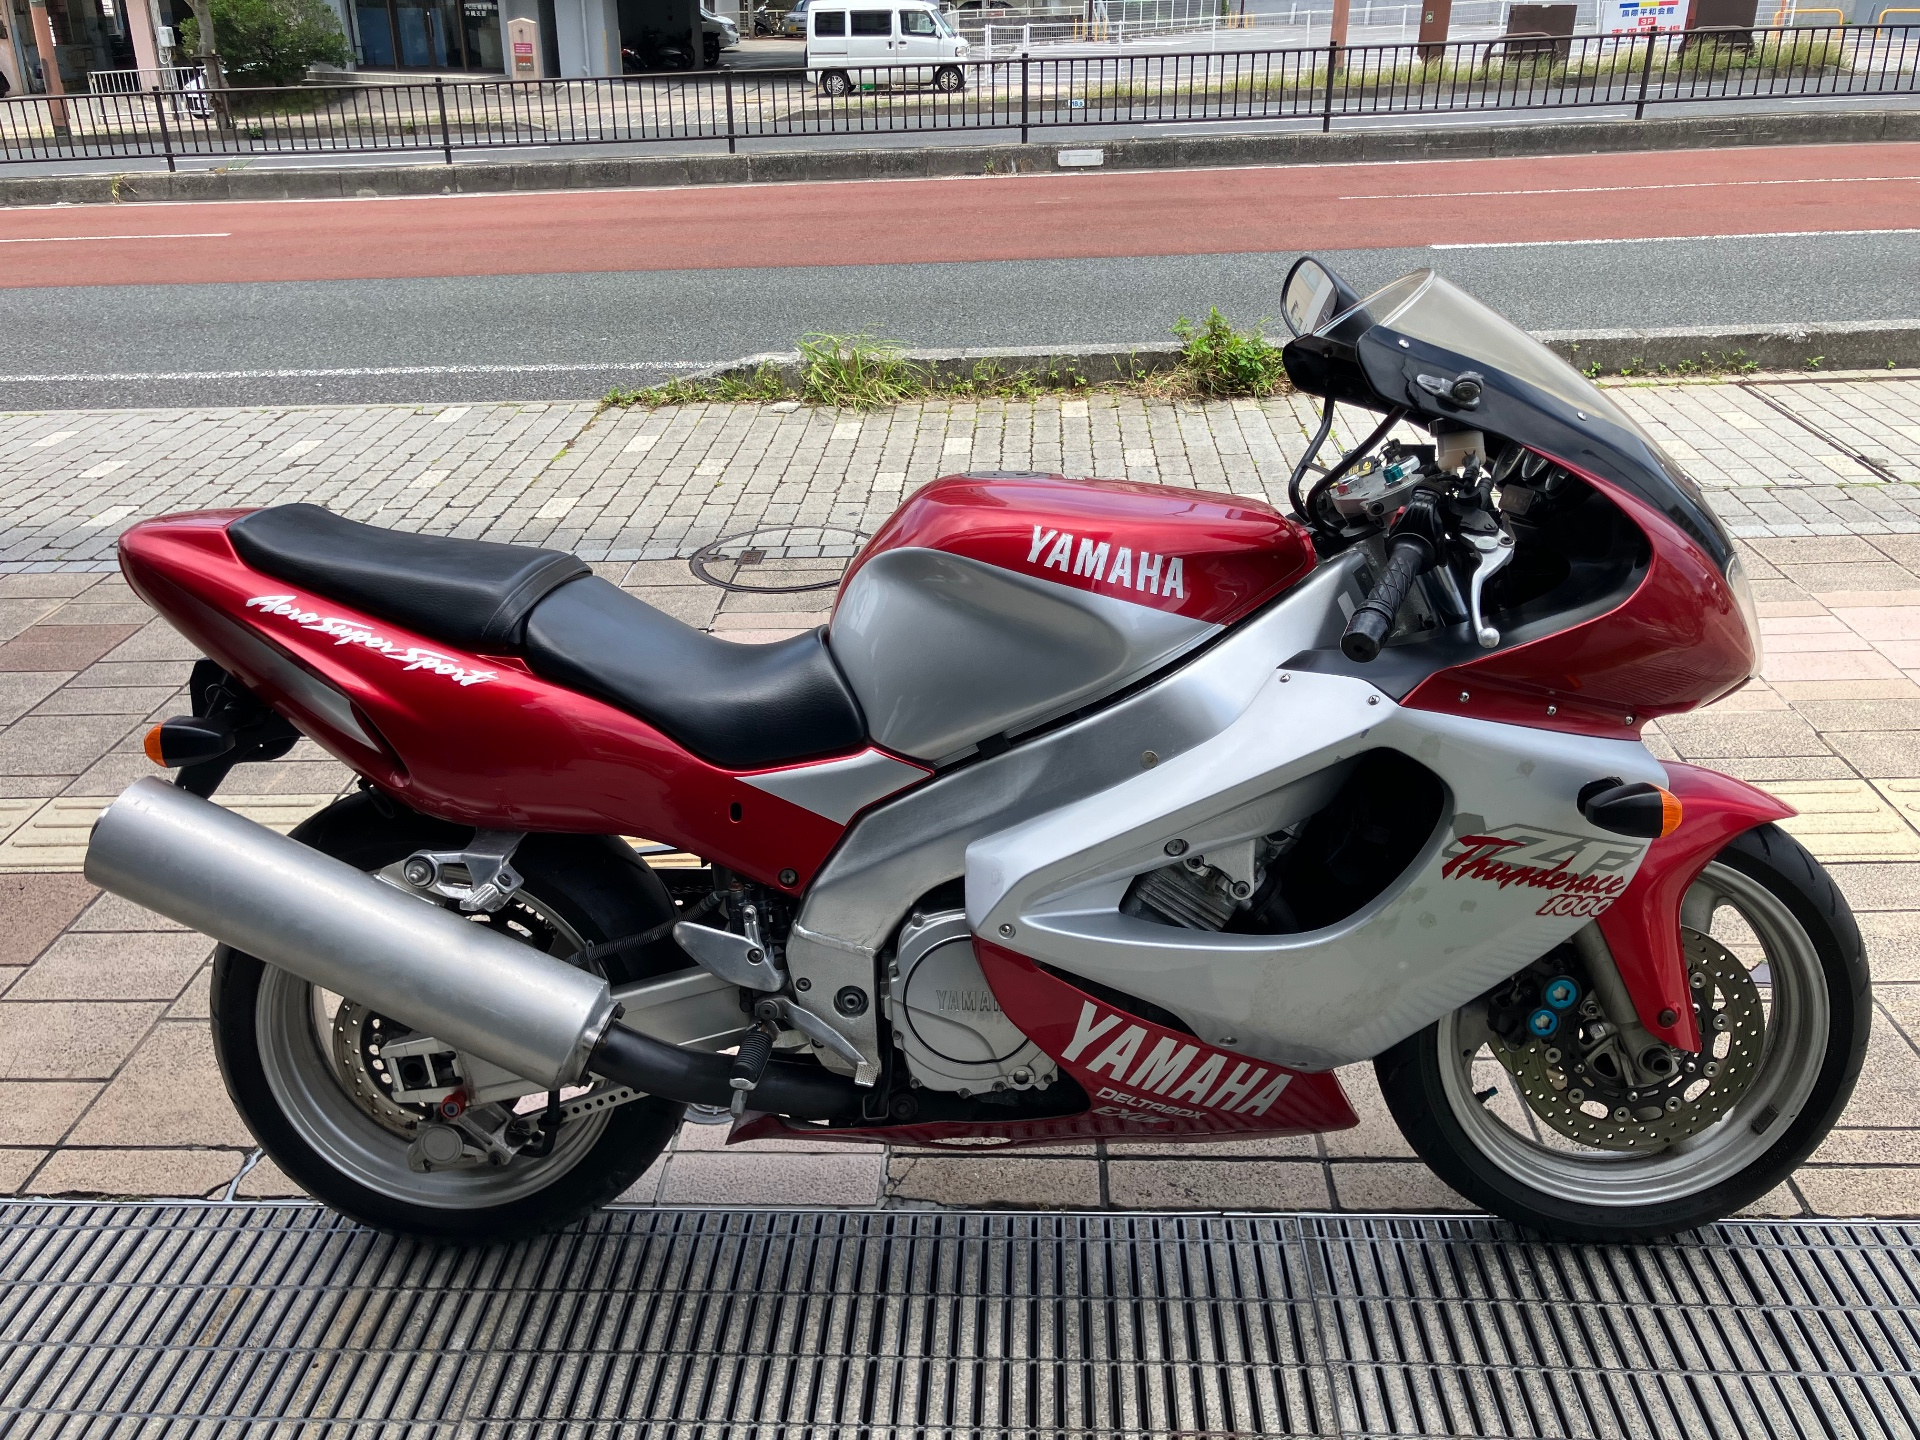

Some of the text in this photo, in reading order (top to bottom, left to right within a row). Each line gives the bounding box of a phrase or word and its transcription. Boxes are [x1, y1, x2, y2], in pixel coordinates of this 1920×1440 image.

[1621, 7, 1674, 17] 国際平和会館
[1026, 524, 1184, 599] YAMAHA
[246, 595, 499, 686] Aero Super Sport
[1441, 835, 1627, 895] Thunderace
[1535, 894, 1615, 918] 1000
[936, 989, 1003, 1012] YAMA
[1061, 1000, 1293, 1117] YAMAHA
[1095, 1086, 1207, 1119] DELTABOX
